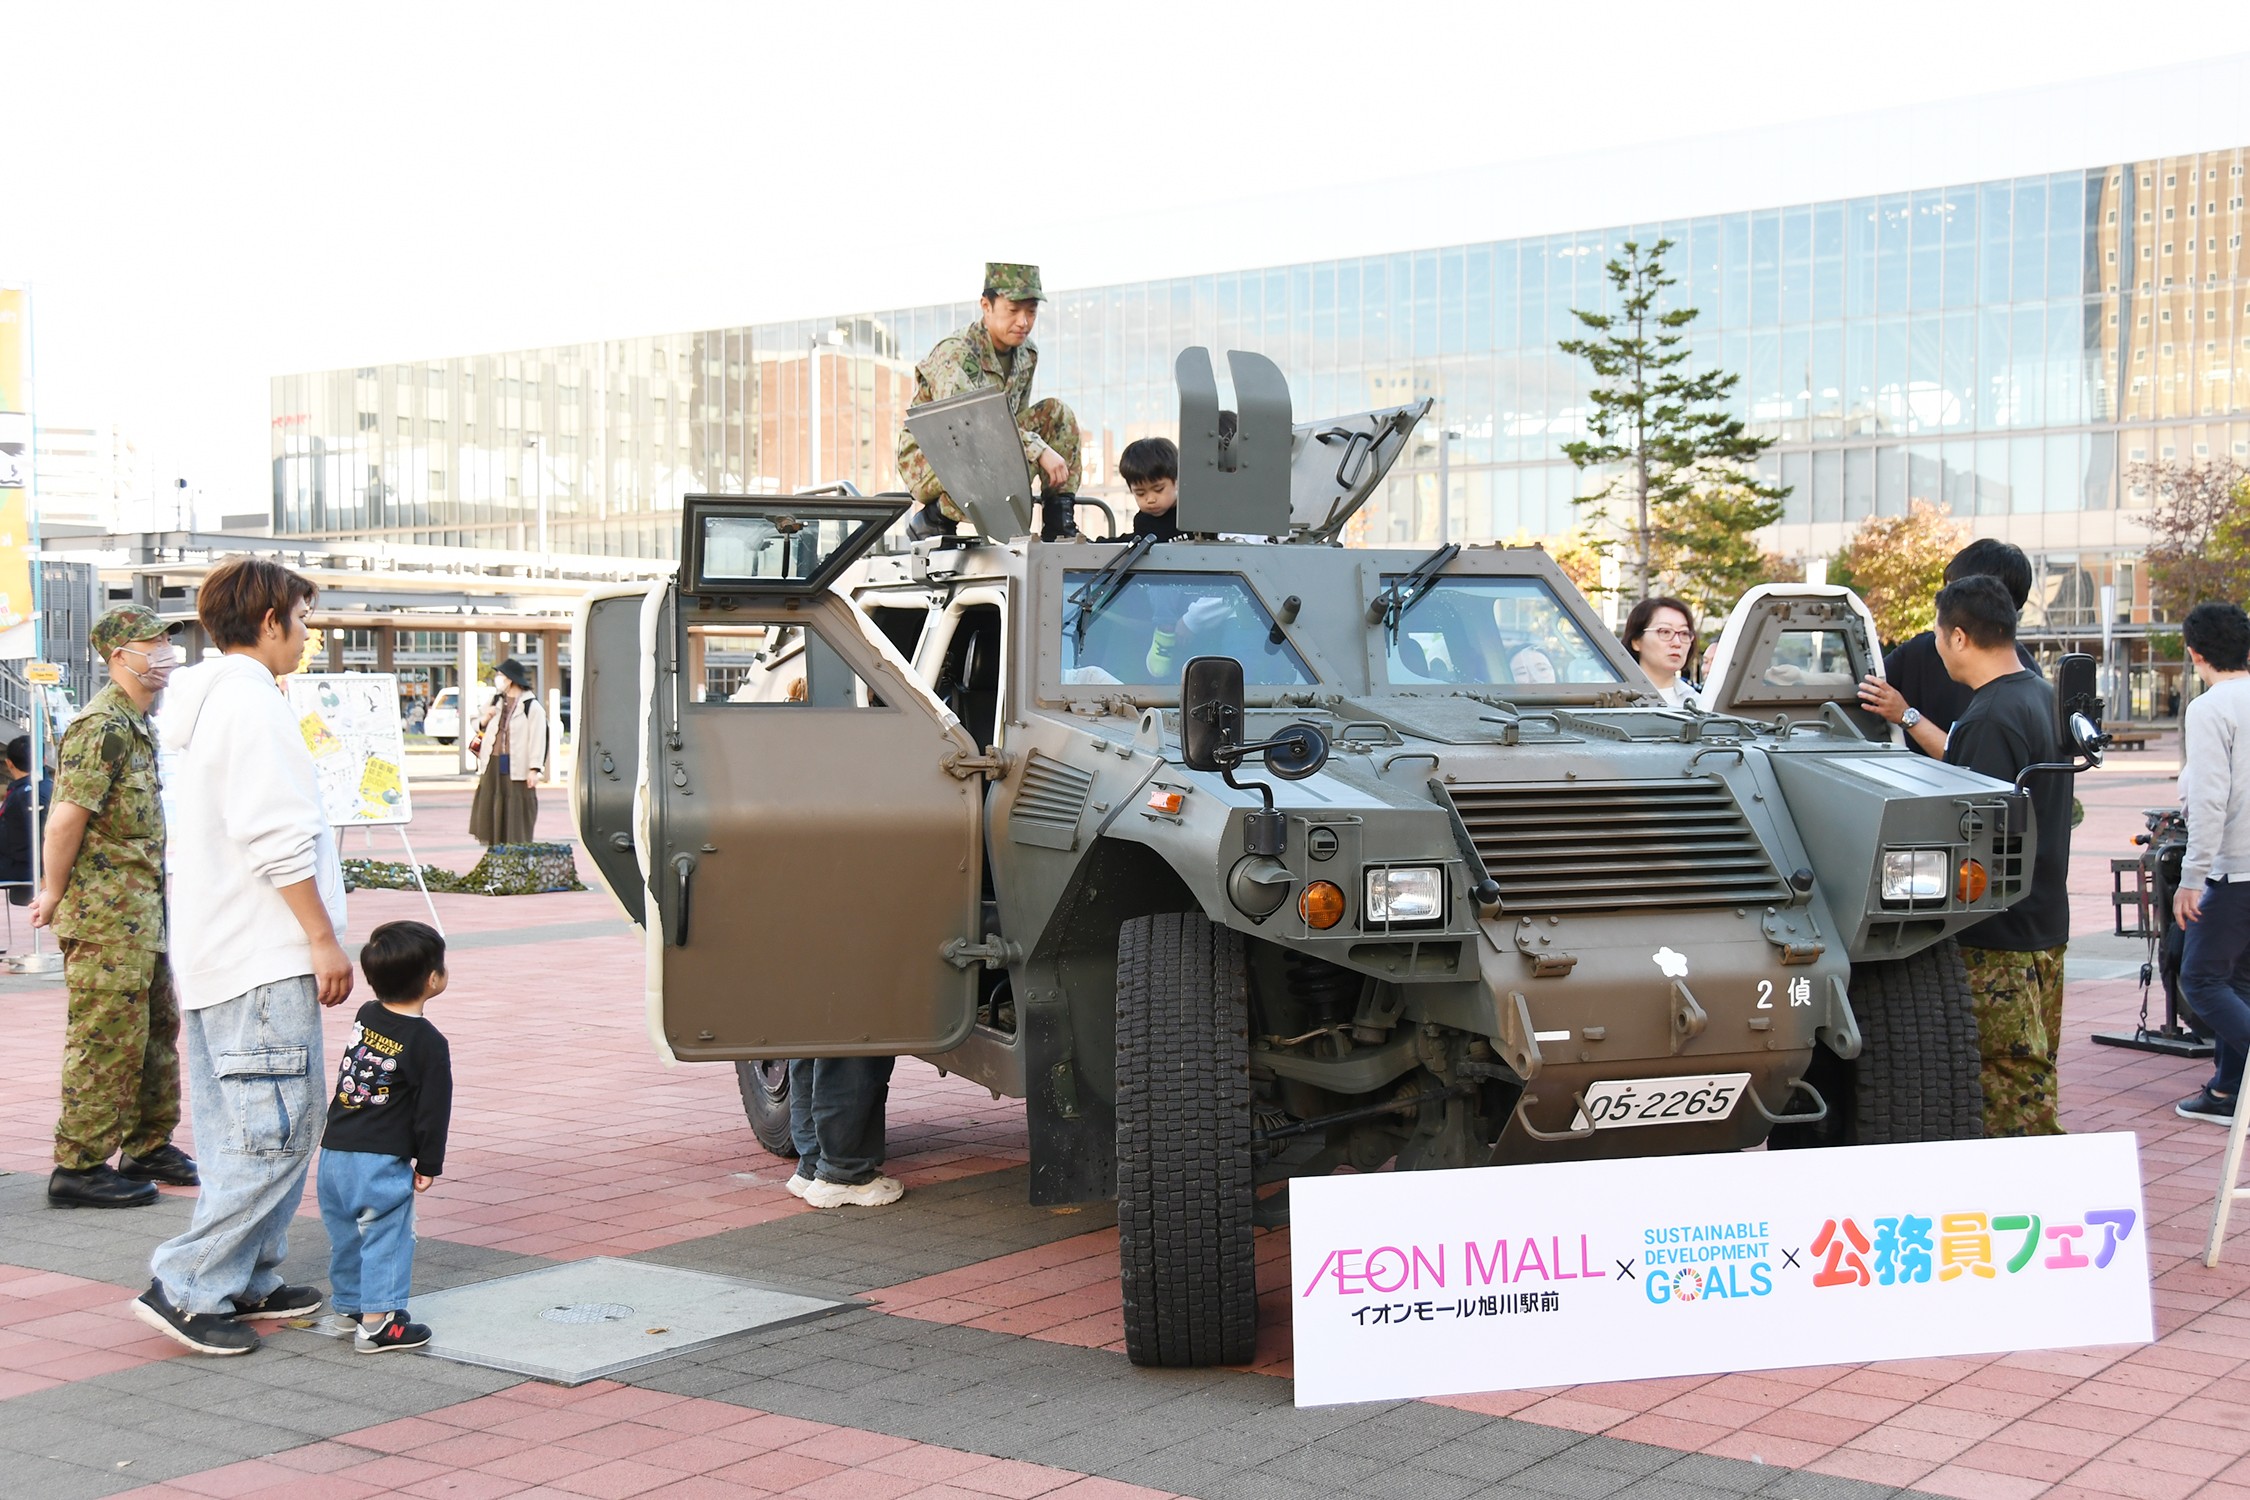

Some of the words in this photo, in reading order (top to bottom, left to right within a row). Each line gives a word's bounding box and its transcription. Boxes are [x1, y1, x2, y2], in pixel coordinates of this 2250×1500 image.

[1756, 980, 1773, 1009] 2
[1787, 977, 1811, 1007] 偵
[364, 1028, 404, 1052] NATIONAL
[364, 1037, 397, 1057] LEAGUE
[1590, 1087, 1735, 1121] 05-2265
[1644, 1222, 1769, 1245] SUSTAINABLE
[1810, 1209, 2136, 1287] 公務員フェア
[1465, 1234, 1605, 1286] MALL
[1645, 1242, 1770, 1265] DEVELOPMENT
[1645, 1262, 1773, 1304] GOALS
[1351, 1291, 1560, 1325] イオンモール旭川駅前
